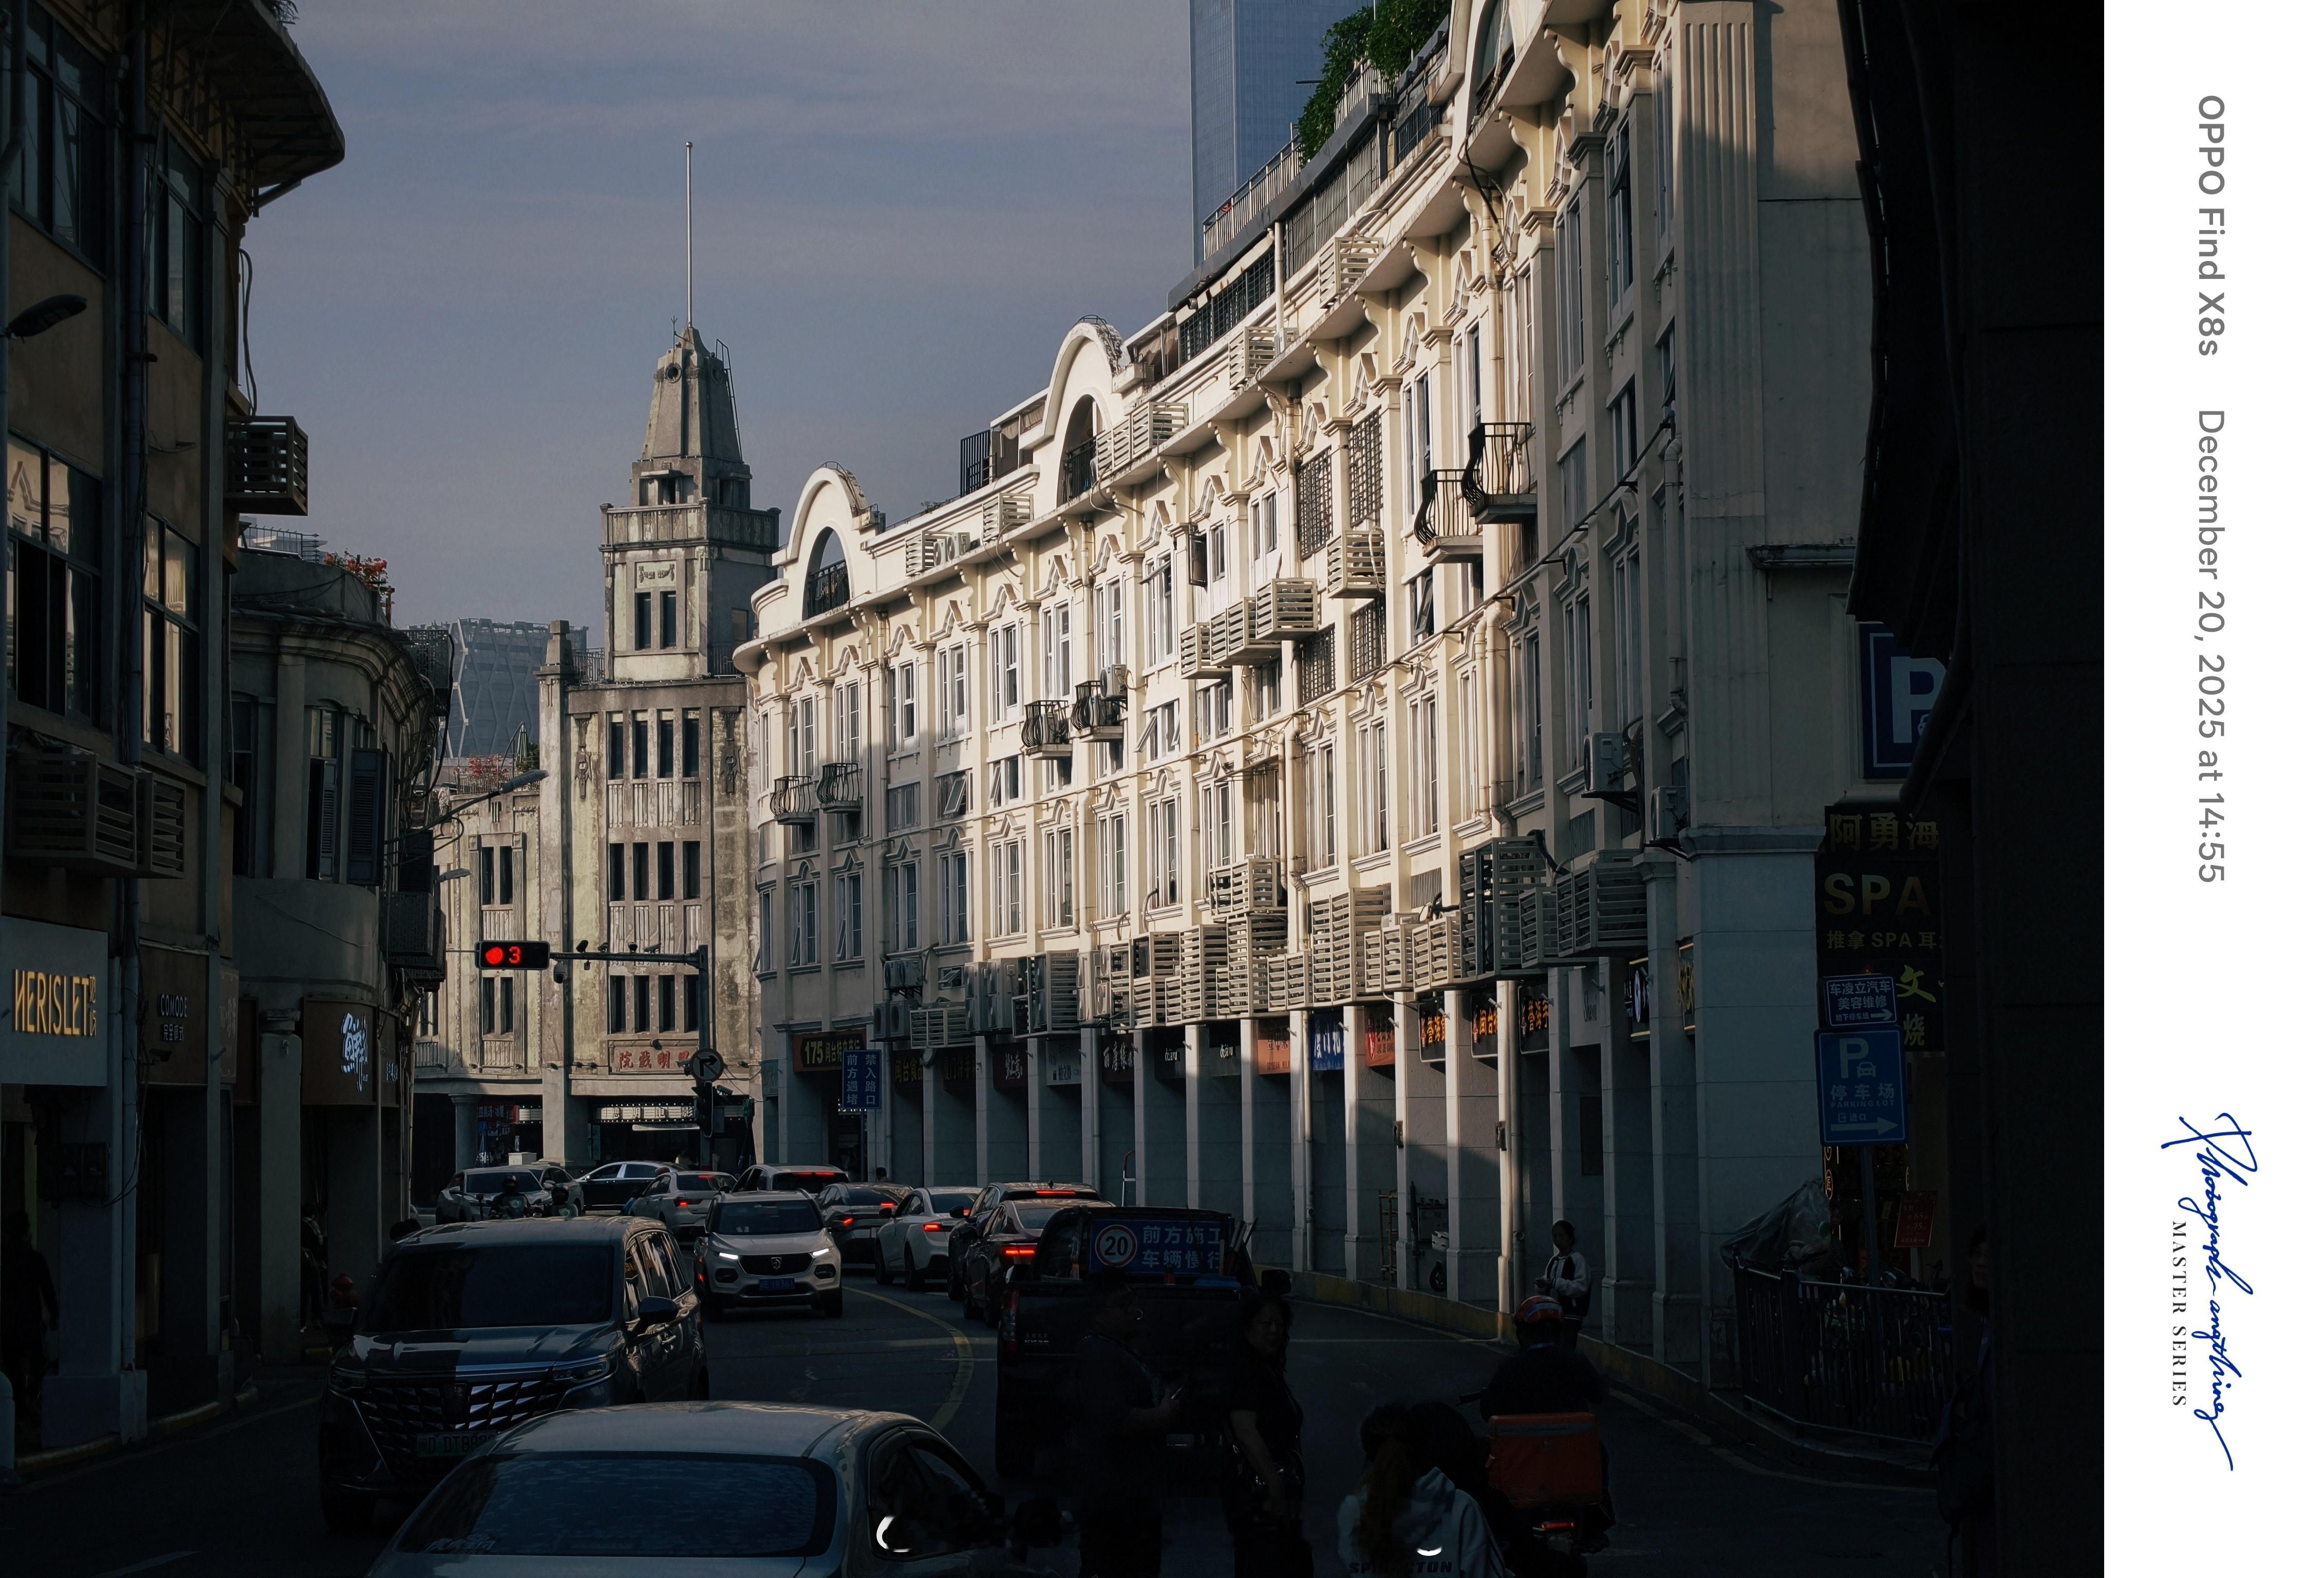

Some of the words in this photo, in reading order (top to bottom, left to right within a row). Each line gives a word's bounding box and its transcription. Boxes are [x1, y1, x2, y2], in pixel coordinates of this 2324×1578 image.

[1890, 656, 1947, 743] P
[1824, 873, 1932, 916] SPA
[1827, 930, 1866, 949] 推拿
[1871, 931, 1913, 948] SPA
[1918, 931, 1942, 949] 耳
[509, 946, 522, 964] 3
[1830, 980, 1891, 995] 车凌立汽车
[14, 969, 89, 1035] HERISLET
[161, 993, 187, 1018] COMODE
[1837, 995, 1888, 1011] 美容维修
[1835, 1012, 1869, 1022] 地下停车场
[1903, 1012, 1925, 1046] 烧
[805, 1041, 823, 1064] 175
[1839, 1038, 1869, 1079] P
[847, 1054, 858, 1105] 前方遇堵
[865, 1053, 877, 1105] 禁入路口
[1830, 1082, 1895, 1101] 停车场
[1830, 1100, 1874, 1109] PARKING
[1849, 1113, 1867, 1122] 进口
[1141, 1225, 1222, 1245] 前方施工
[1104, 1236, 1128, 1256] 20
[1141, 1249, 1220, 1269] 车辆慢行
